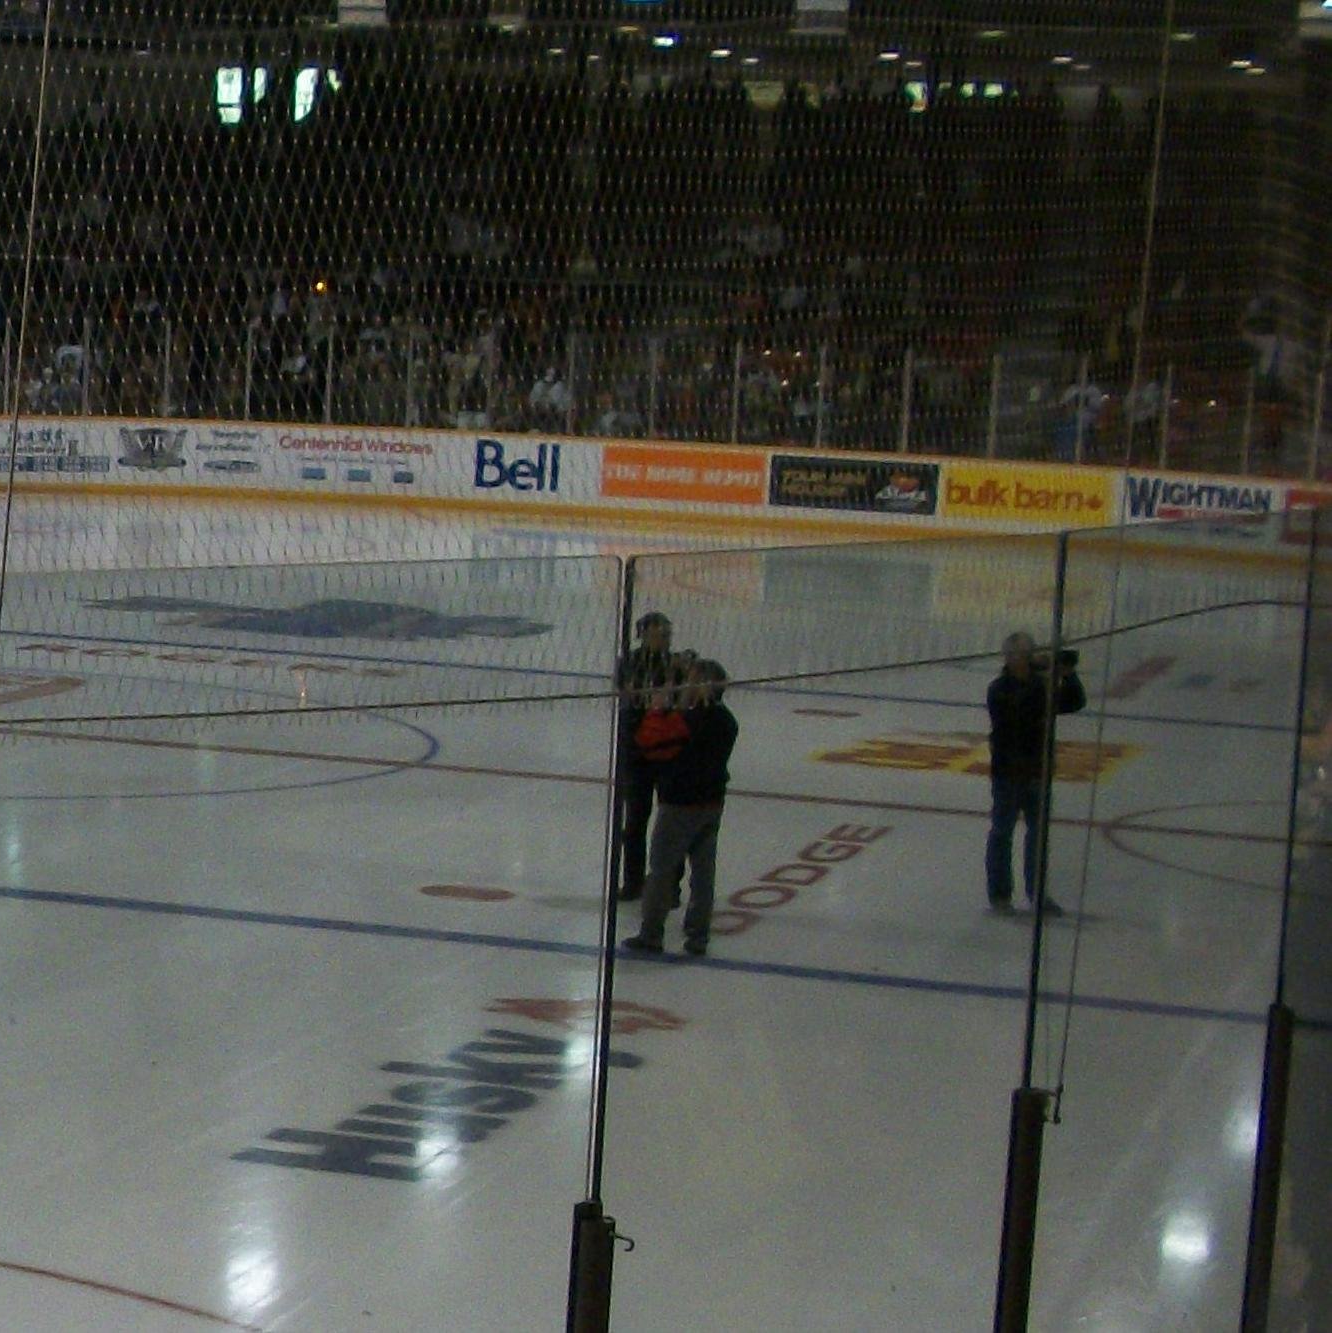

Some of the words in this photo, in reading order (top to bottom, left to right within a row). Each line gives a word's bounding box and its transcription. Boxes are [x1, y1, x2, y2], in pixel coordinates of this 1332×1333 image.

[279, 434, 362, 452] Centennial
[366, 438, 432, 455] Windows
[474, 439, 561, 492] Bell
[946, 478, 1008, 508] bulk
[1013, 481, 1083, 512] barn
[1126, 477, 1273, 519] WIGHTMAN
